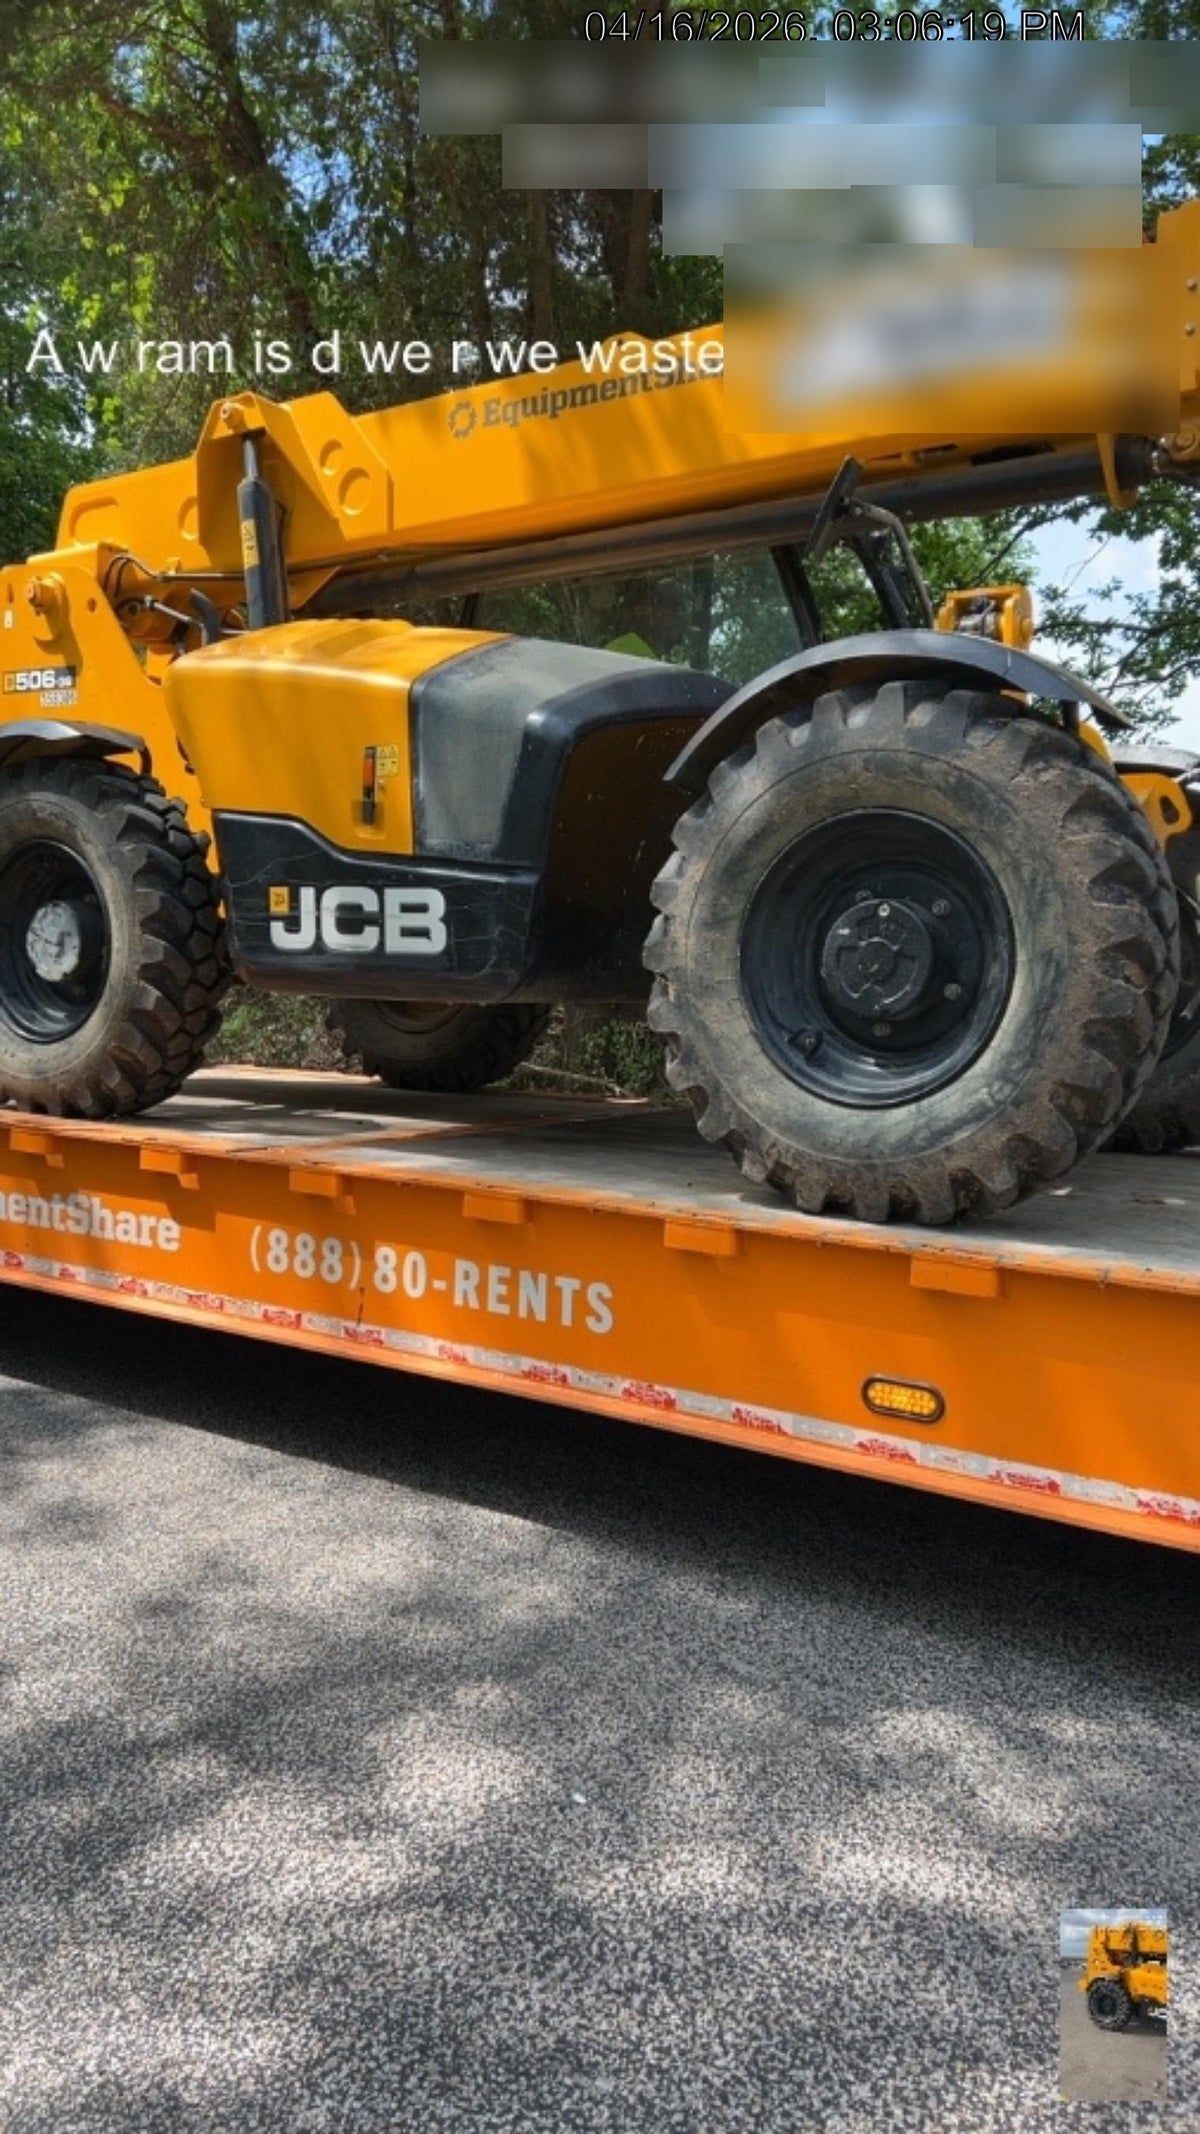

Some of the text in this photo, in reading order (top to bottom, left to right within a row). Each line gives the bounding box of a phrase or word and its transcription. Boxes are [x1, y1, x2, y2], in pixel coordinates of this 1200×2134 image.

[269, 886, 448, 955] JCB
[250, 1225, 614, 1334] (888) 80-RENTS
